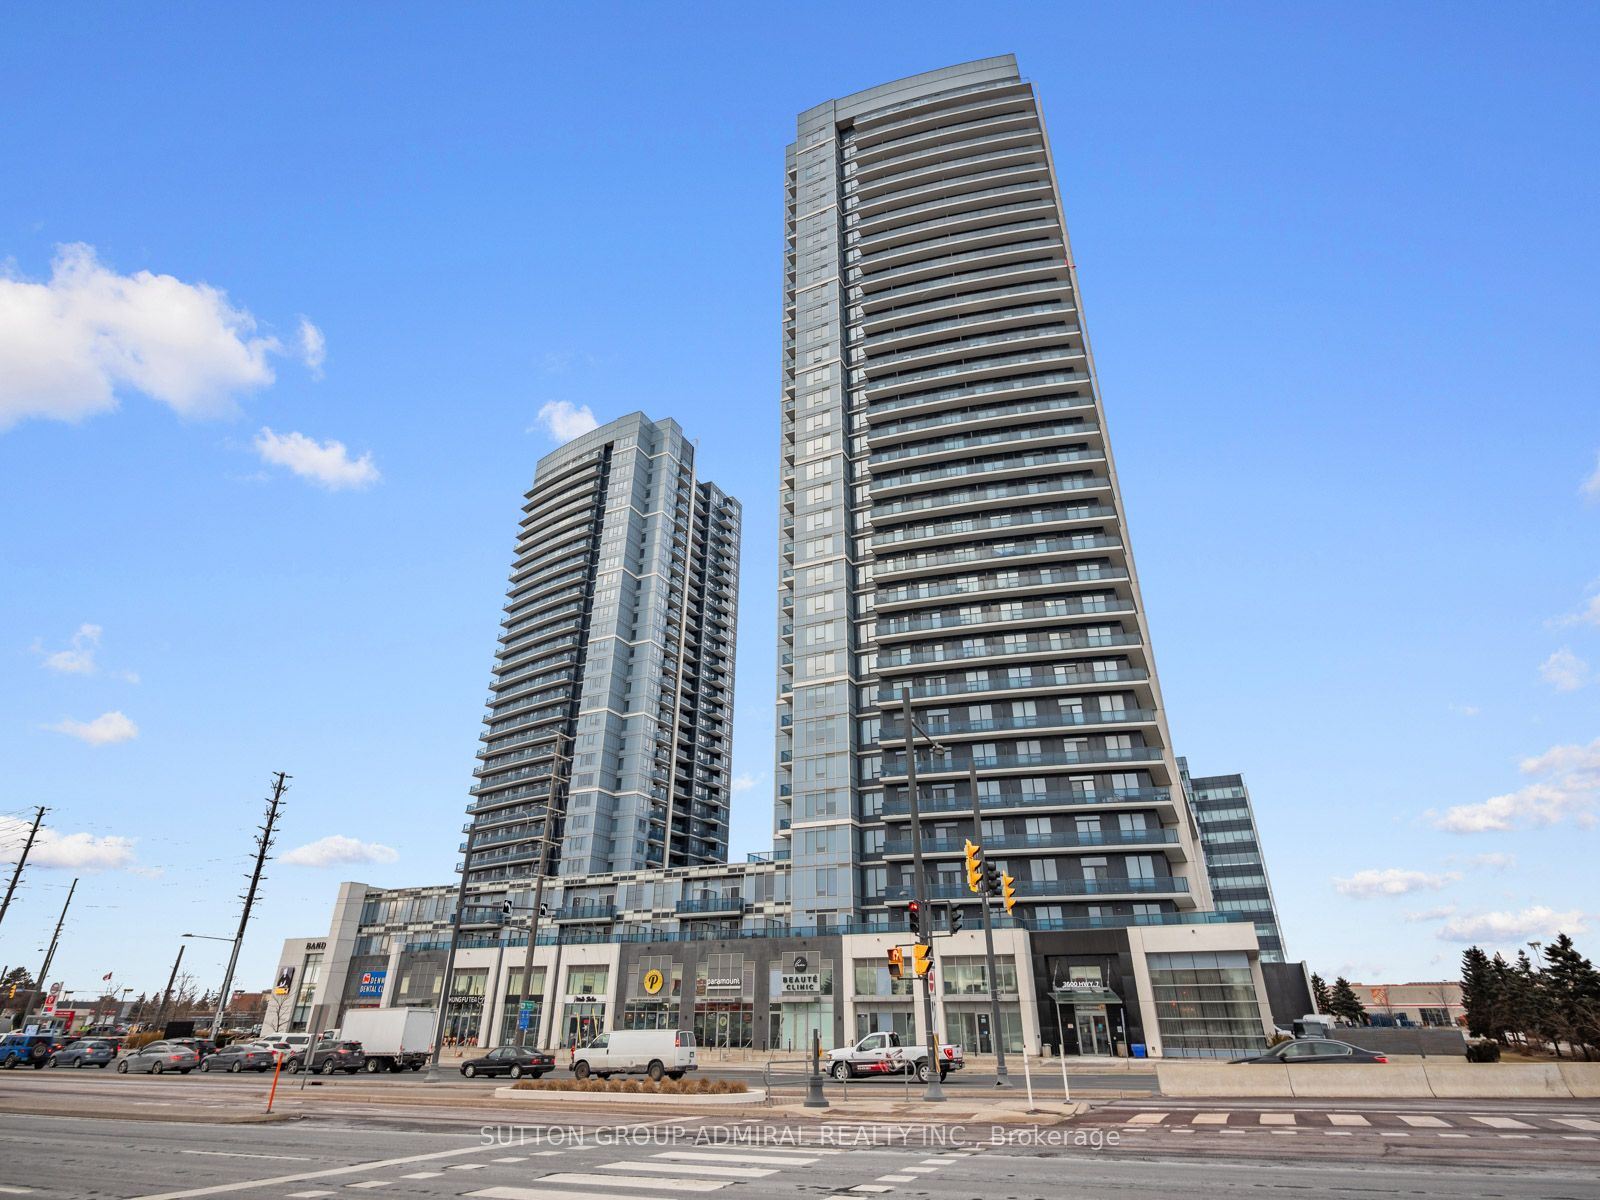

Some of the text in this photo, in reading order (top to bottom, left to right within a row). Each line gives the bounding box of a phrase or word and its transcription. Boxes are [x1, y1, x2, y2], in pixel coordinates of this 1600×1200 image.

[707, 977, 740, 986] paramount
[782, 974, 818, 983] BEAUTÉ
[360, 985, 377, 993] DENTAL
